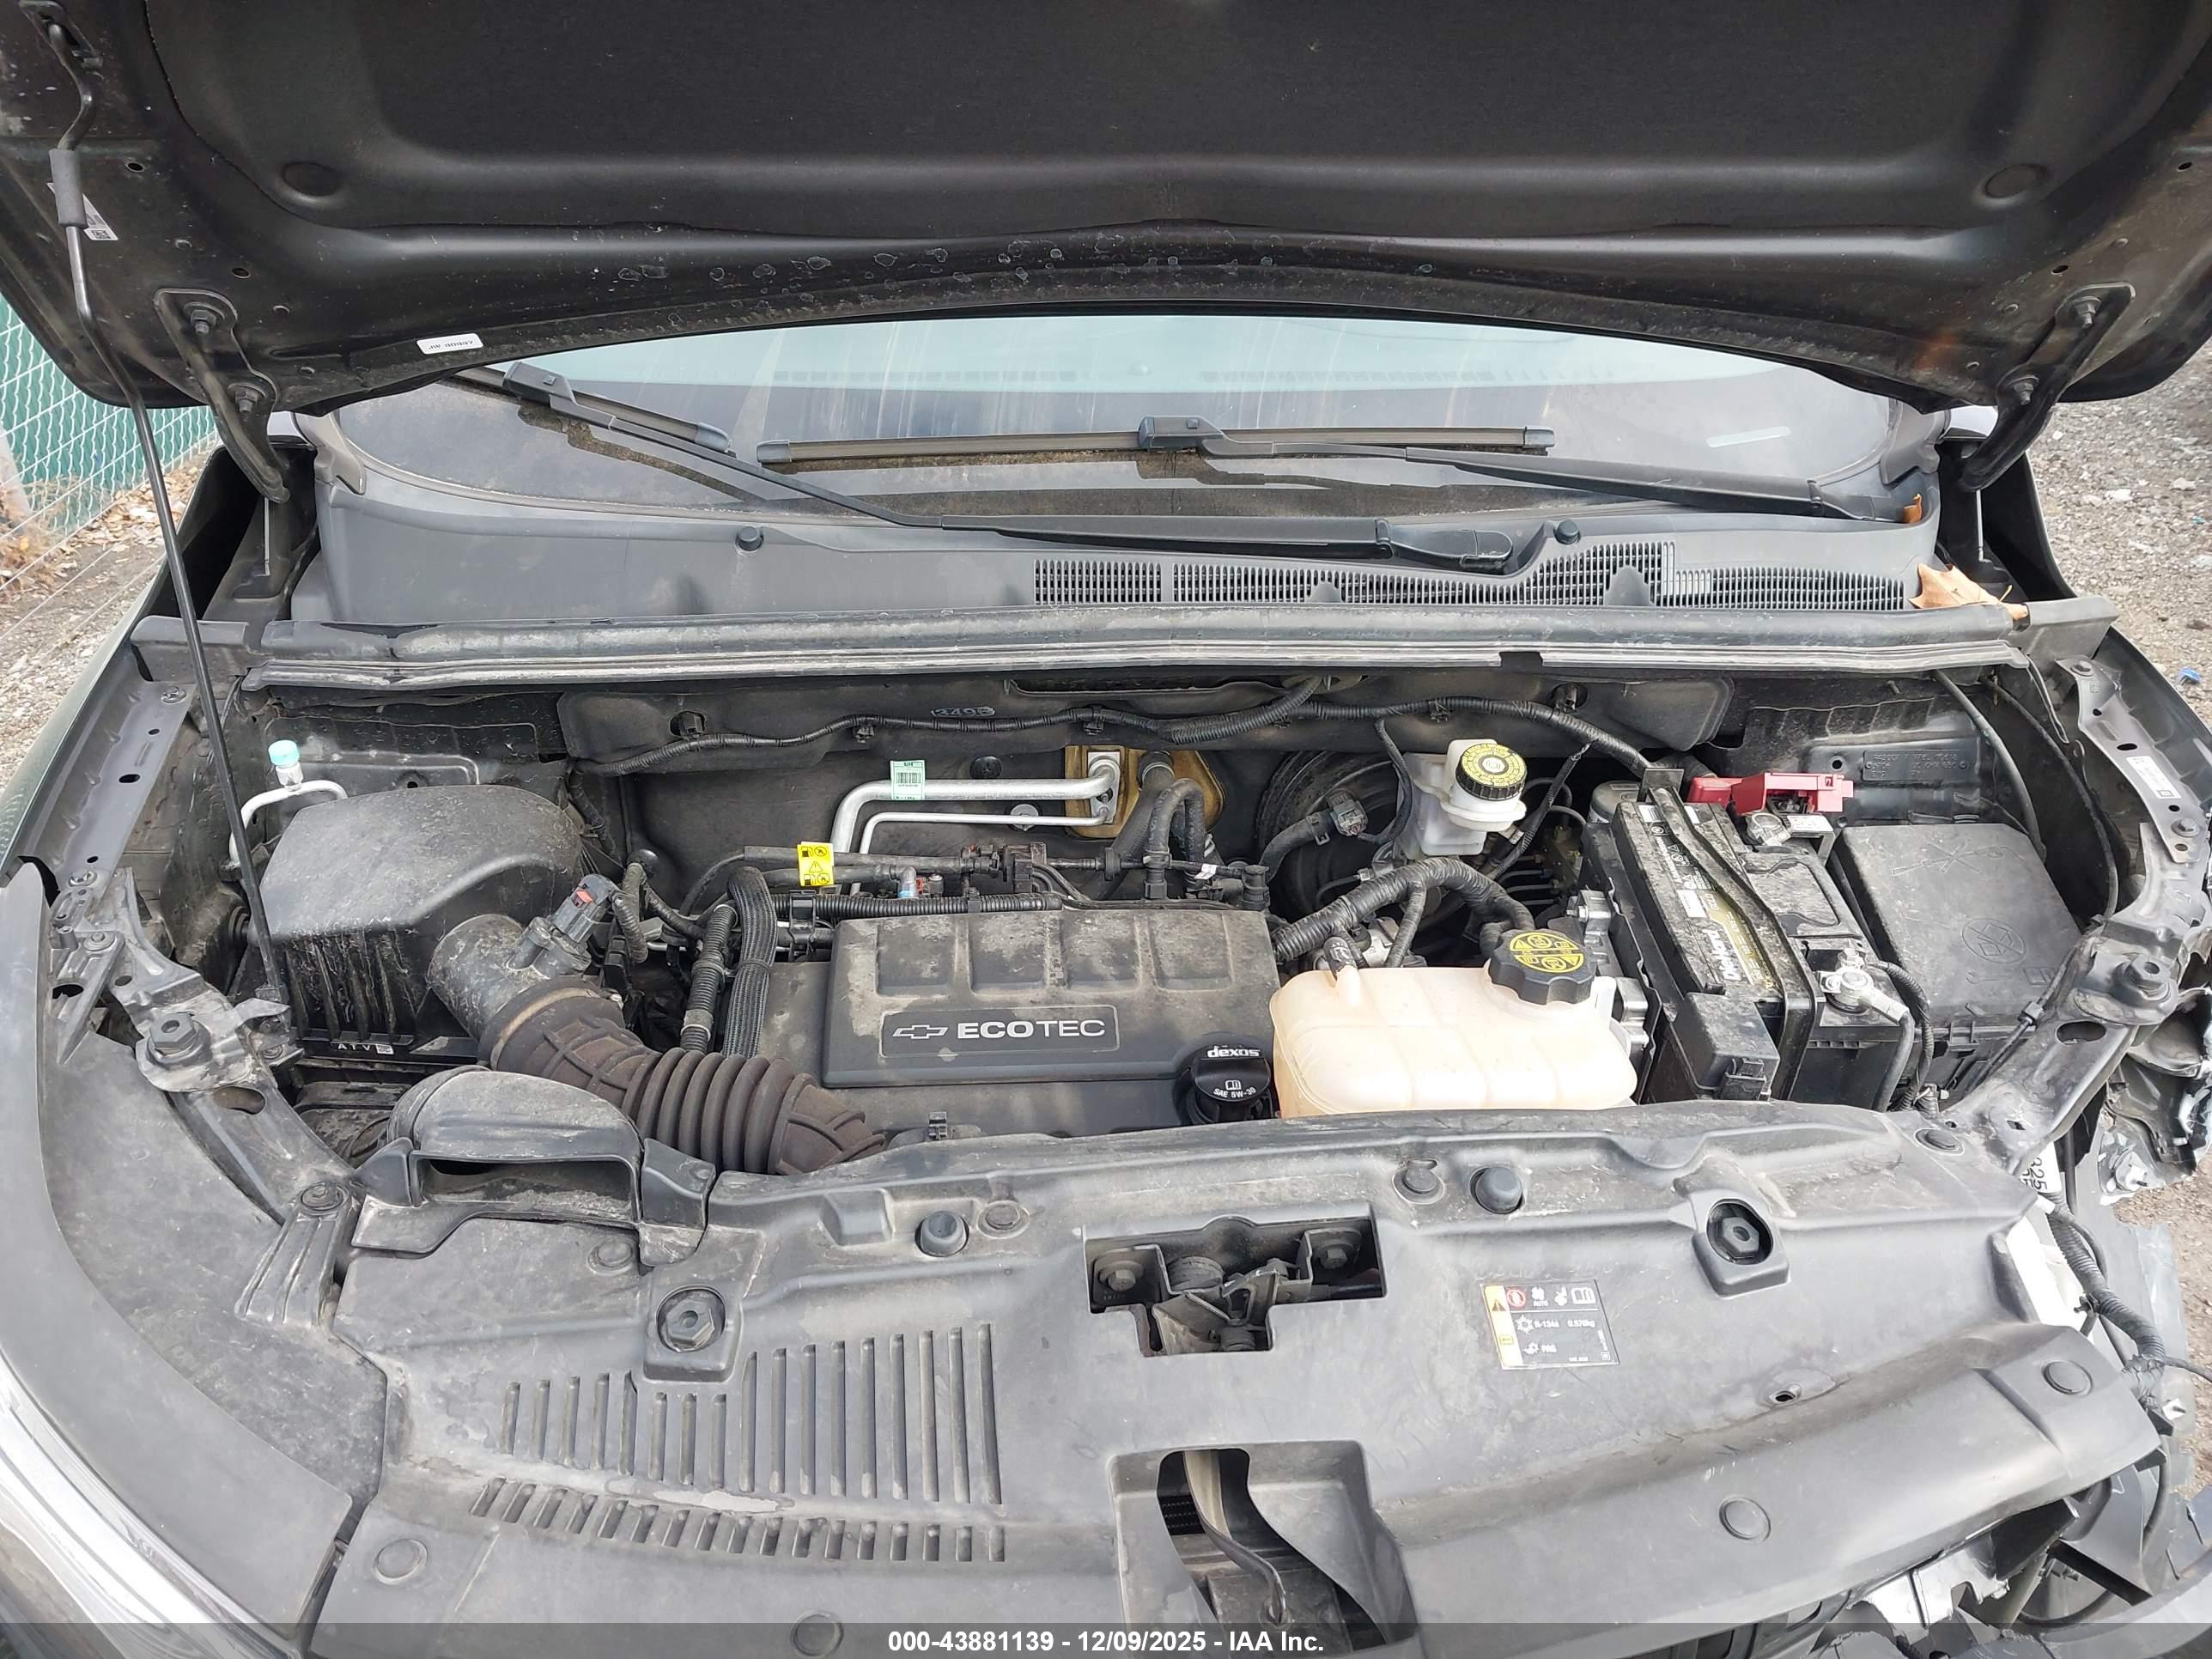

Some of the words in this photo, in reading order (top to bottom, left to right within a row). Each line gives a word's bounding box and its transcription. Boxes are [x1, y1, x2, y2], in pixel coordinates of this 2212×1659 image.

[957, 1020, 1106, 1039] ECOTEC
[1206, 1046, 1261, 1058] dexos
[1212, 1088, 1229, 1098] SAE
[1231, 1086, 1256, 1098] 5W-30
